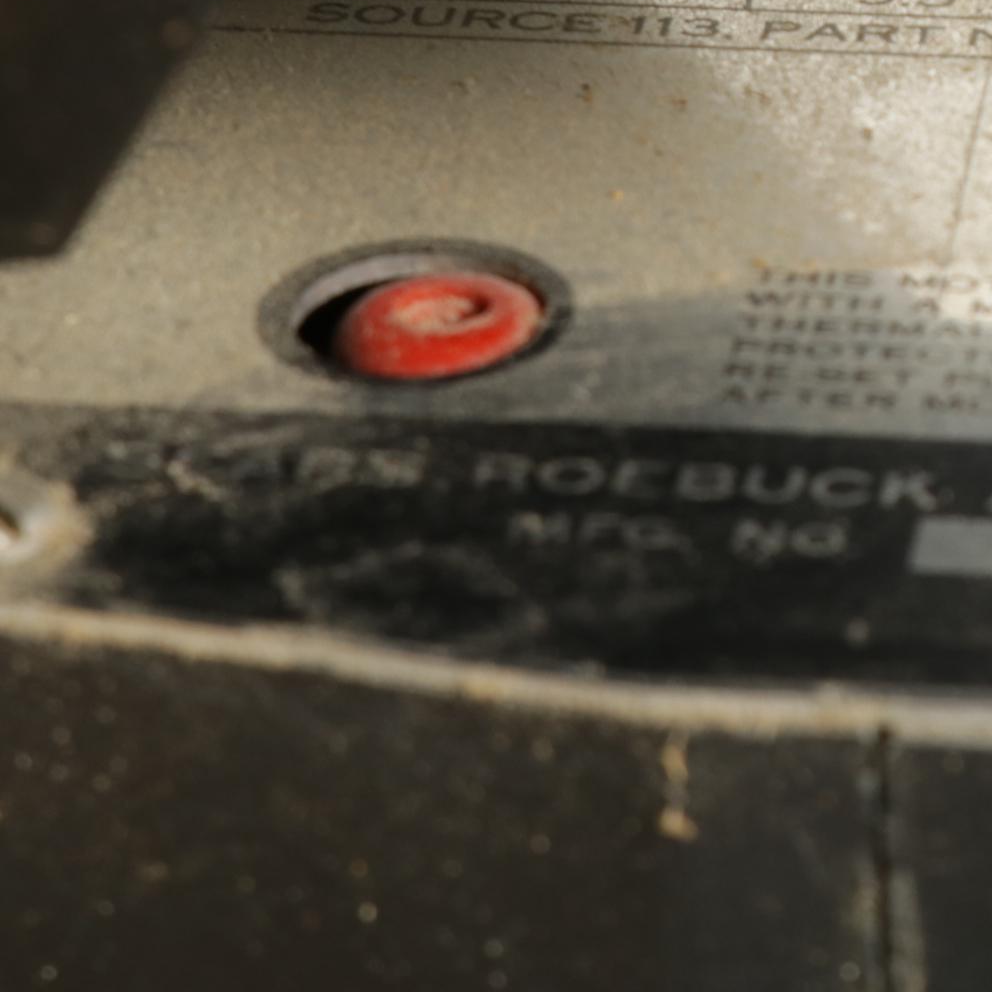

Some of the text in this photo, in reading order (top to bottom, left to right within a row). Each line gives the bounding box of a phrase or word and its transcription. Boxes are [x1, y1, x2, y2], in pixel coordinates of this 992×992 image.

[304, 1, 596, 35] SOURCE
[760, 19, 944, 47] PART
[744, 289, 886, 310] WITH
[740, 312, 984, 340] THERMAL
